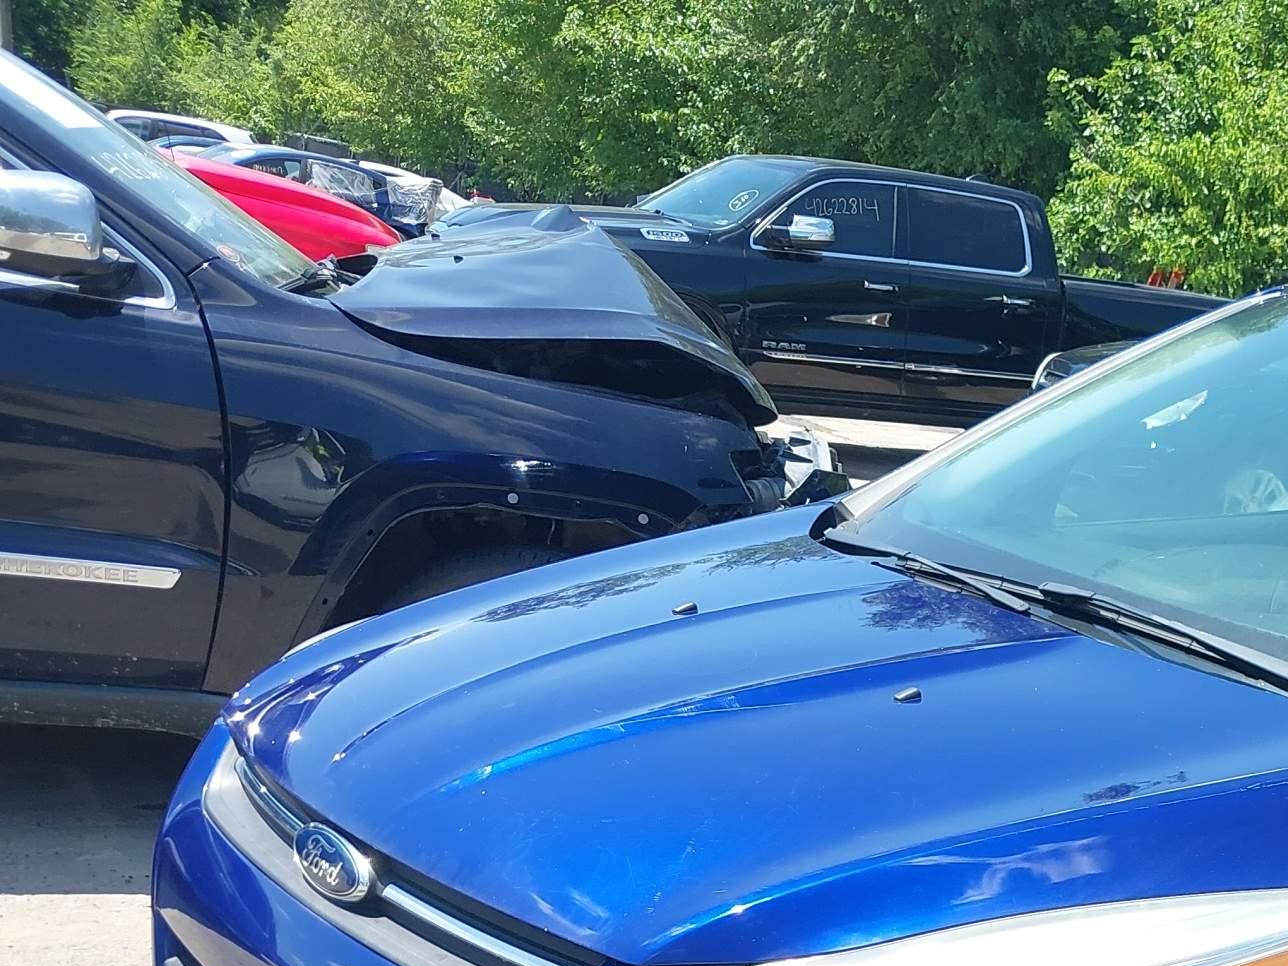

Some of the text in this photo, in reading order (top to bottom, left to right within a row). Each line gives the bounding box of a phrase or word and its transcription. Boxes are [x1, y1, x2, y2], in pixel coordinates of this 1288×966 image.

[804, 197, 880, 222] 42622814
[761, 340, 807, 350] RAM
[0, 558, 139, 583] HEROKEE
[303, 834, 344, 887] Ford
